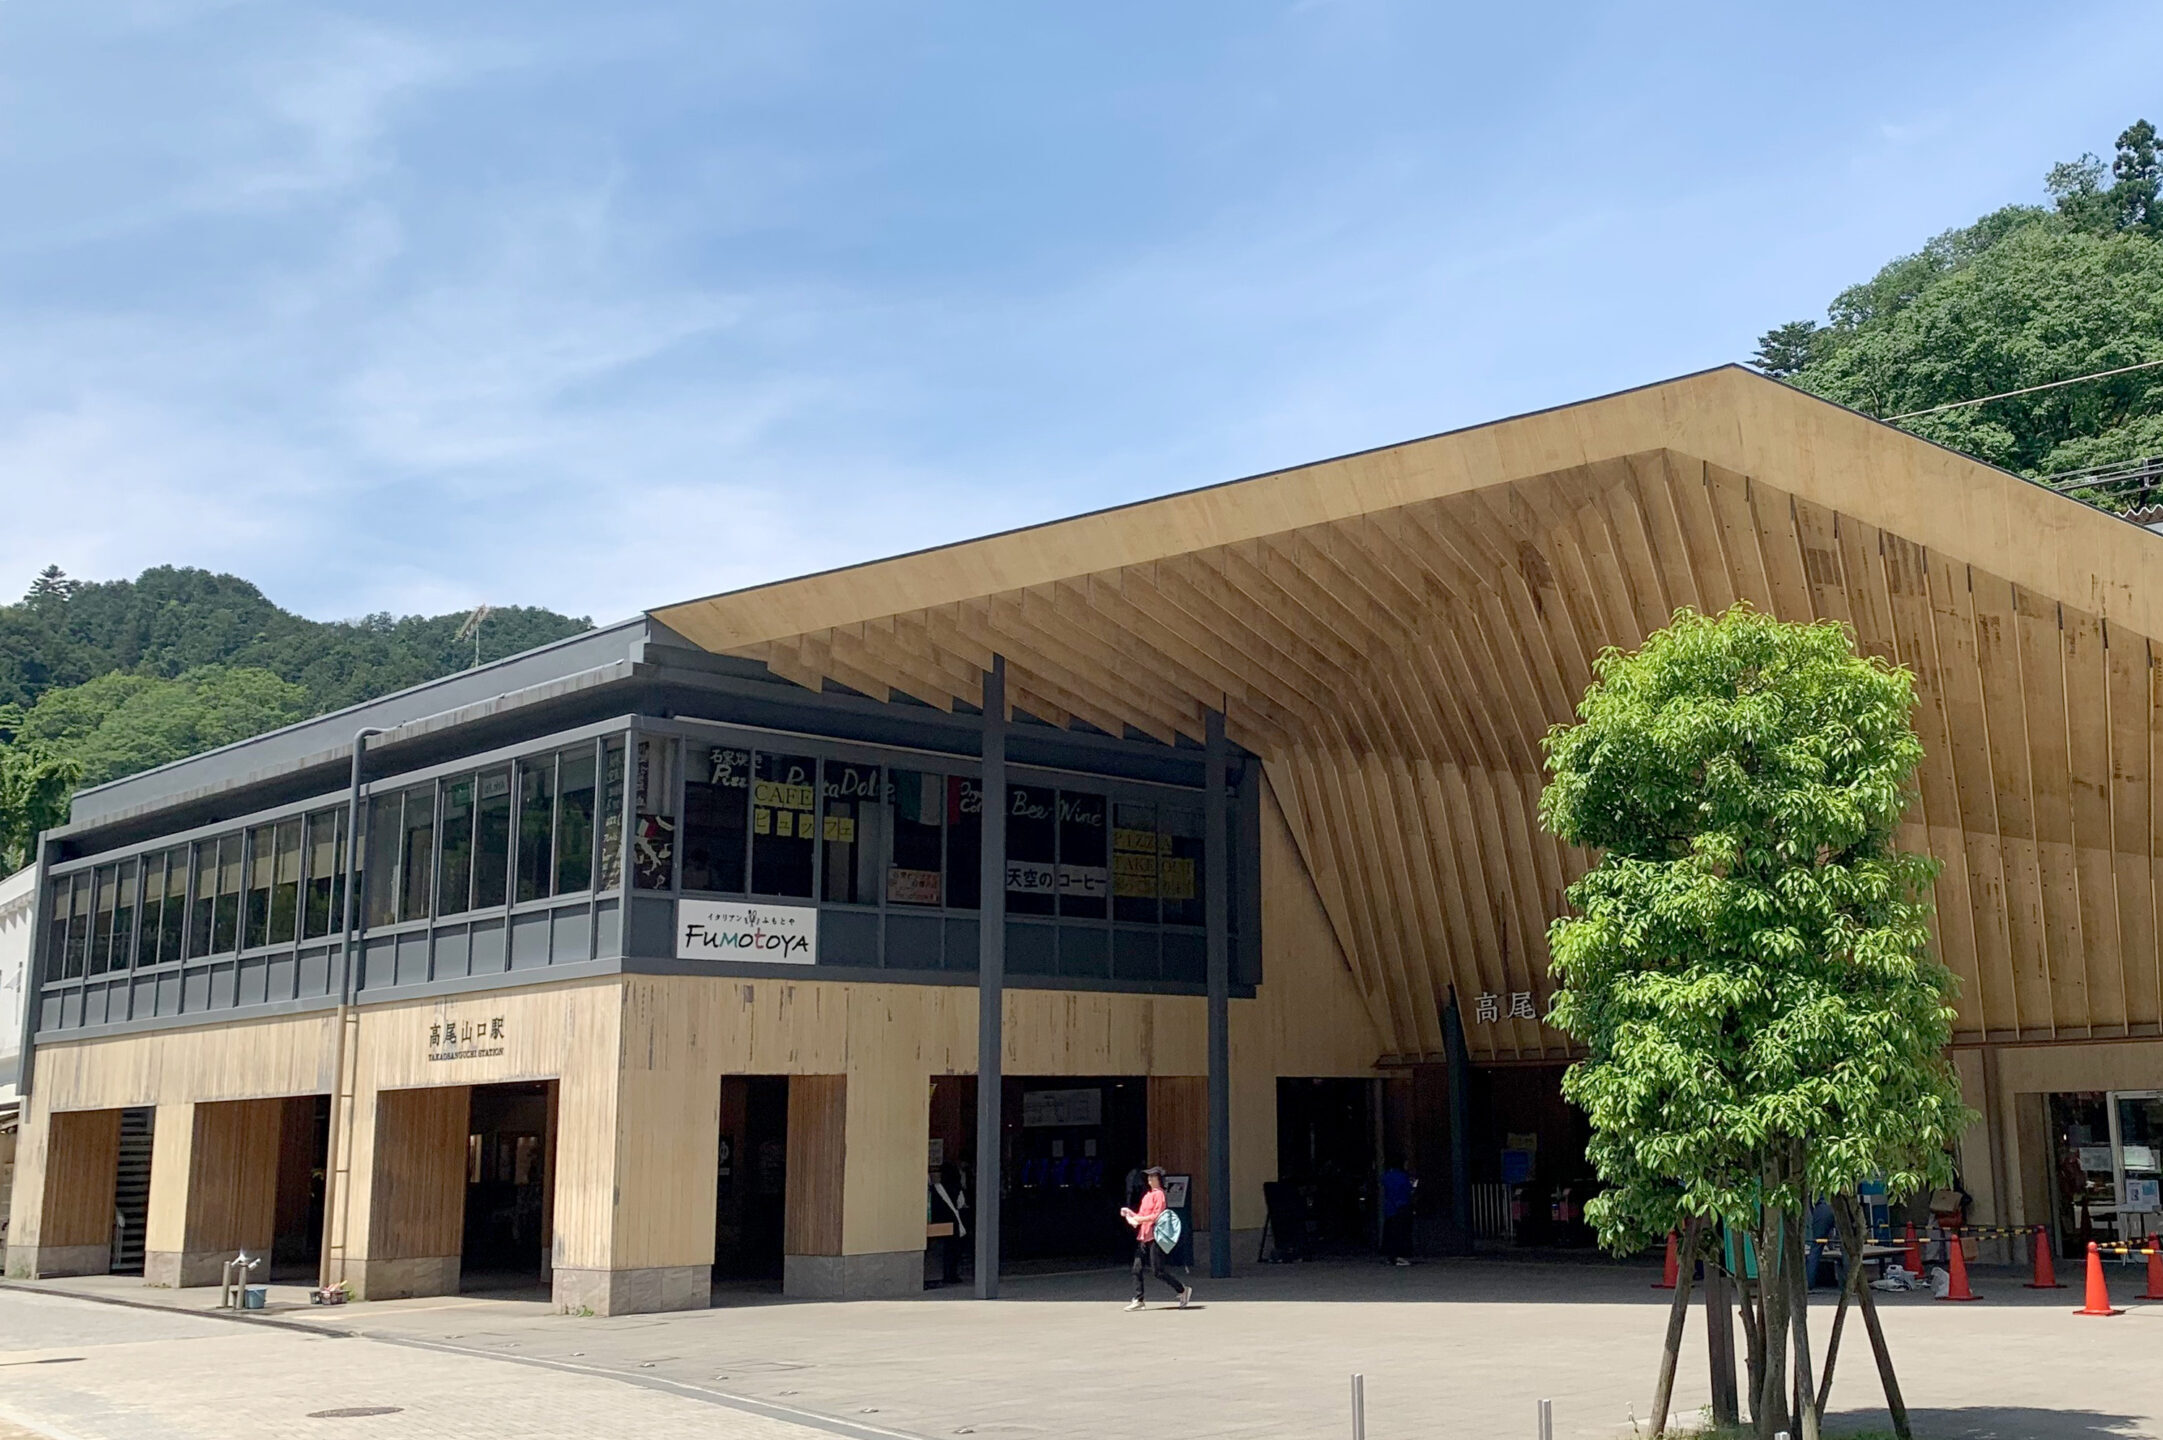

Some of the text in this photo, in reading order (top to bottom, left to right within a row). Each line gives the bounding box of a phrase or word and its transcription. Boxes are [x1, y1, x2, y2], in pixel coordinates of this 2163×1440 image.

[755, 783, 813, 808] CAFE
[755, 812, 853, 837] ビュッフェ
[1007, 868, 1106, 891] 天空のコーヒー
[707, 912, 796, 926] イタリアン ふもとや
[1473, 990, 1553, 1025] 高尾
[430, 1017, 504, 1048] 高尾山口駅
[477, 1047, 505, 1058] STATION
